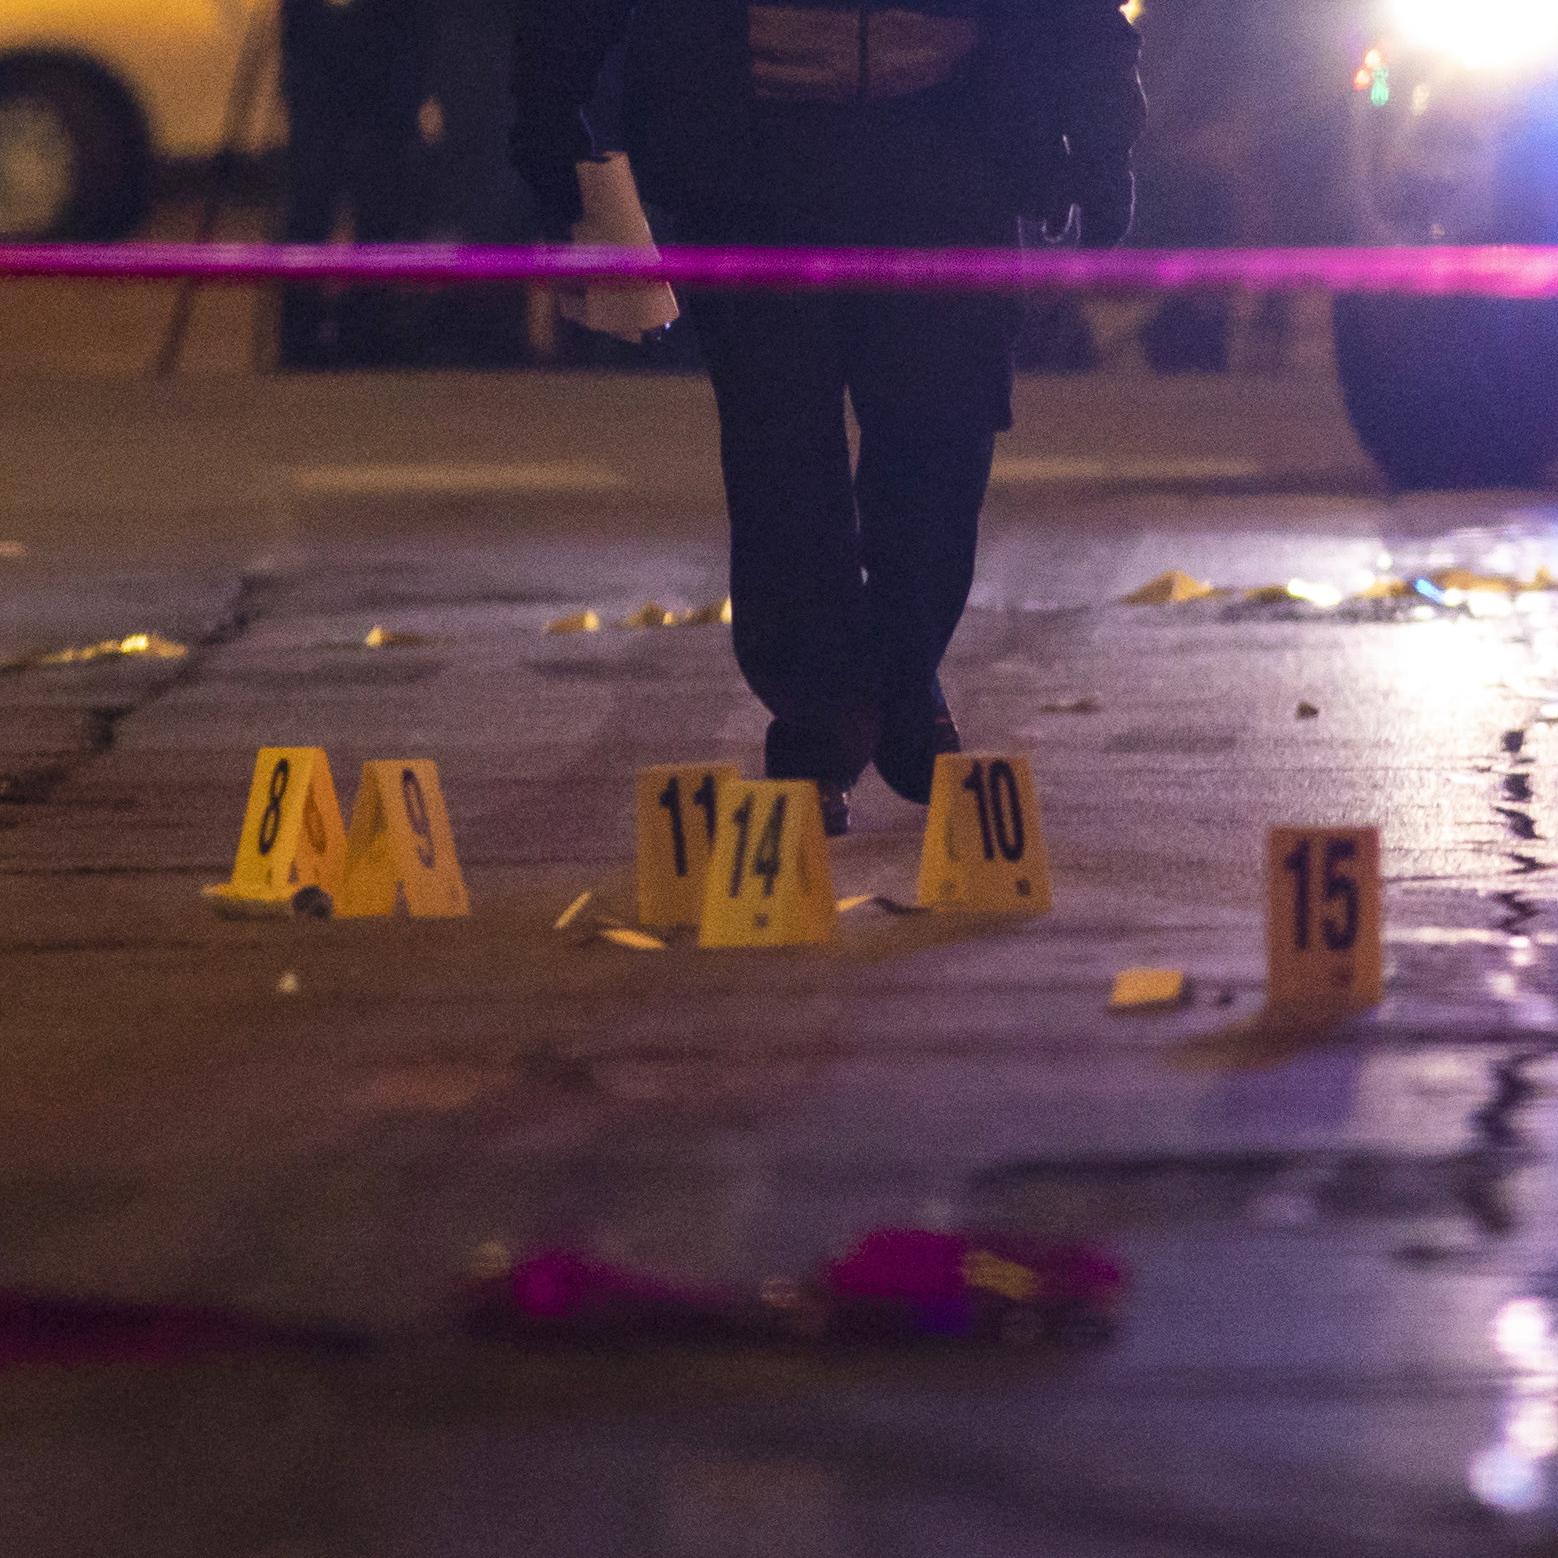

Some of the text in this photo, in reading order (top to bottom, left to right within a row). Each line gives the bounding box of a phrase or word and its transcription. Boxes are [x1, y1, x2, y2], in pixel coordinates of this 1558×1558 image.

[258, 758, 290, 855] 8
[402, 768, 437, 869] 9
[729, 792, 788, 898] 14
[962, 759, 1024, 861] 10
[1284, 839, 1359, 950] 15
